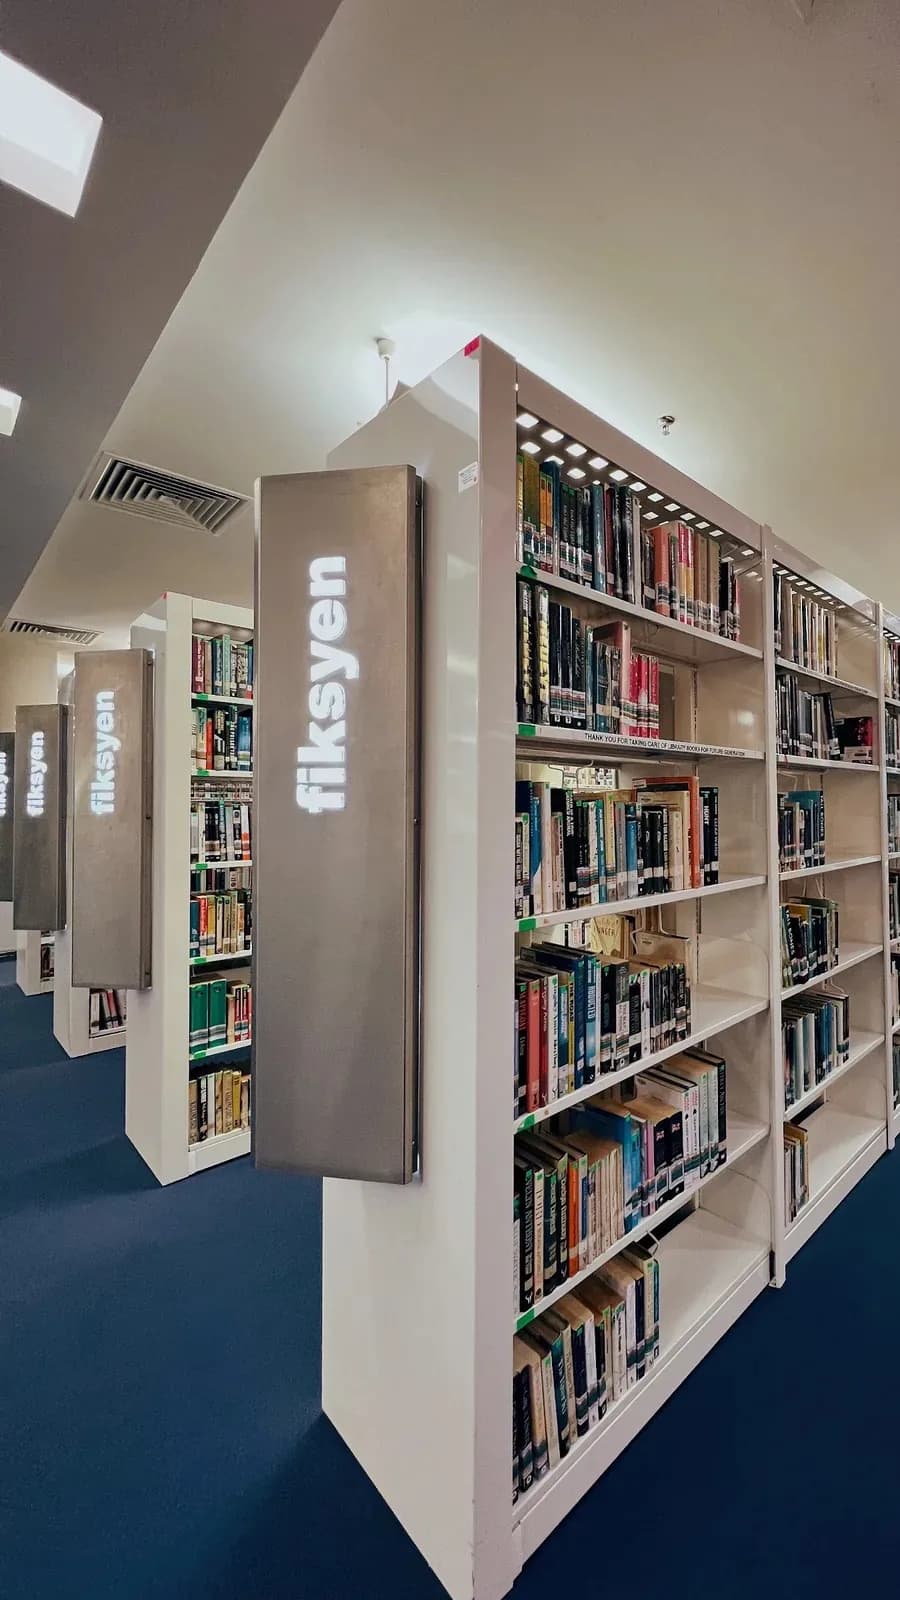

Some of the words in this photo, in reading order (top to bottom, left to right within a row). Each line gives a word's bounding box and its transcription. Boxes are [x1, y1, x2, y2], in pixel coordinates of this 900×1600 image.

[296, 556, 360, 814] fiksyen
[26, 731, 48, 817] fiksyen
[91, 690, 122, 815] fiksyen
[585, 732, 603, 741] THANK
[605, 735, 617, 744] YOU
